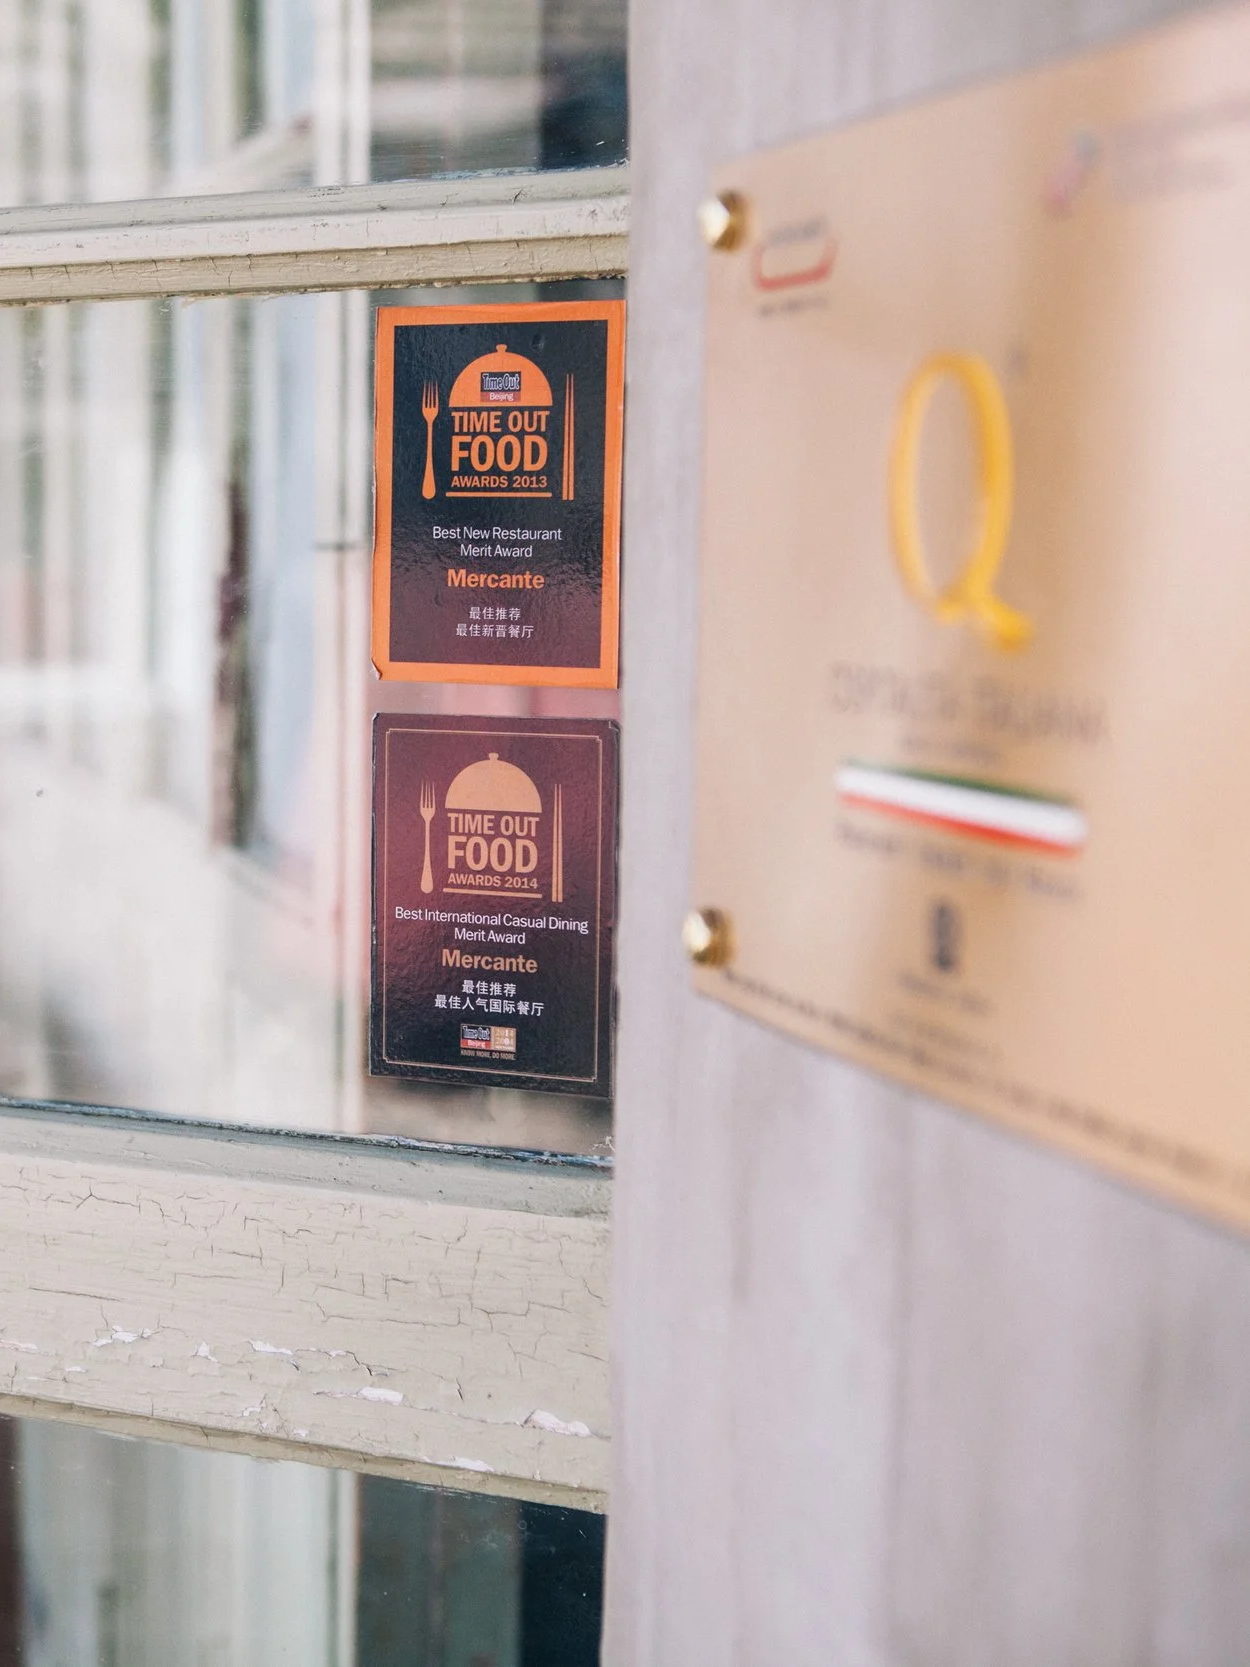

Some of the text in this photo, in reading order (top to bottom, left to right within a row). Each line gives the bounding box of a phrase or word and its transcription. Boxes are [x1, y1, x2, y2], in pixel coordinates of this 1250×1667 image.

[482, 373, 520, 390] Time Out
[451, 411, 550, 433] TIME OUT
[451, 435, 548, 472] FOOD
[451, 476, 548, 488] AWARDS 2013
[887, 348, 1032, 654] Q
[433, 526, 562, 540] Best New Restaurant
[460, 544, 533, 558] Merit Award
[447, 569, 545, 589] Mercante
[469, 606, 521, 621] 最佳推荐
[456, 623, 534, 639] 最佳新晋餐厅
[447, 813, 540, 837] TIME OUT
[447, 835, 538, 873] FOOD
[448, 873, 538, 889] AWARDS 2014
[395, 906, 589, 934] Best International Casual Dining
[454, 927, 526, 944] Merit Award
[442, 949, 538, 974] Mercante
[462, 980, 516, 997] 最佳推荐
[434, 994, 545, 1017] 最佳人气国际餐厅
